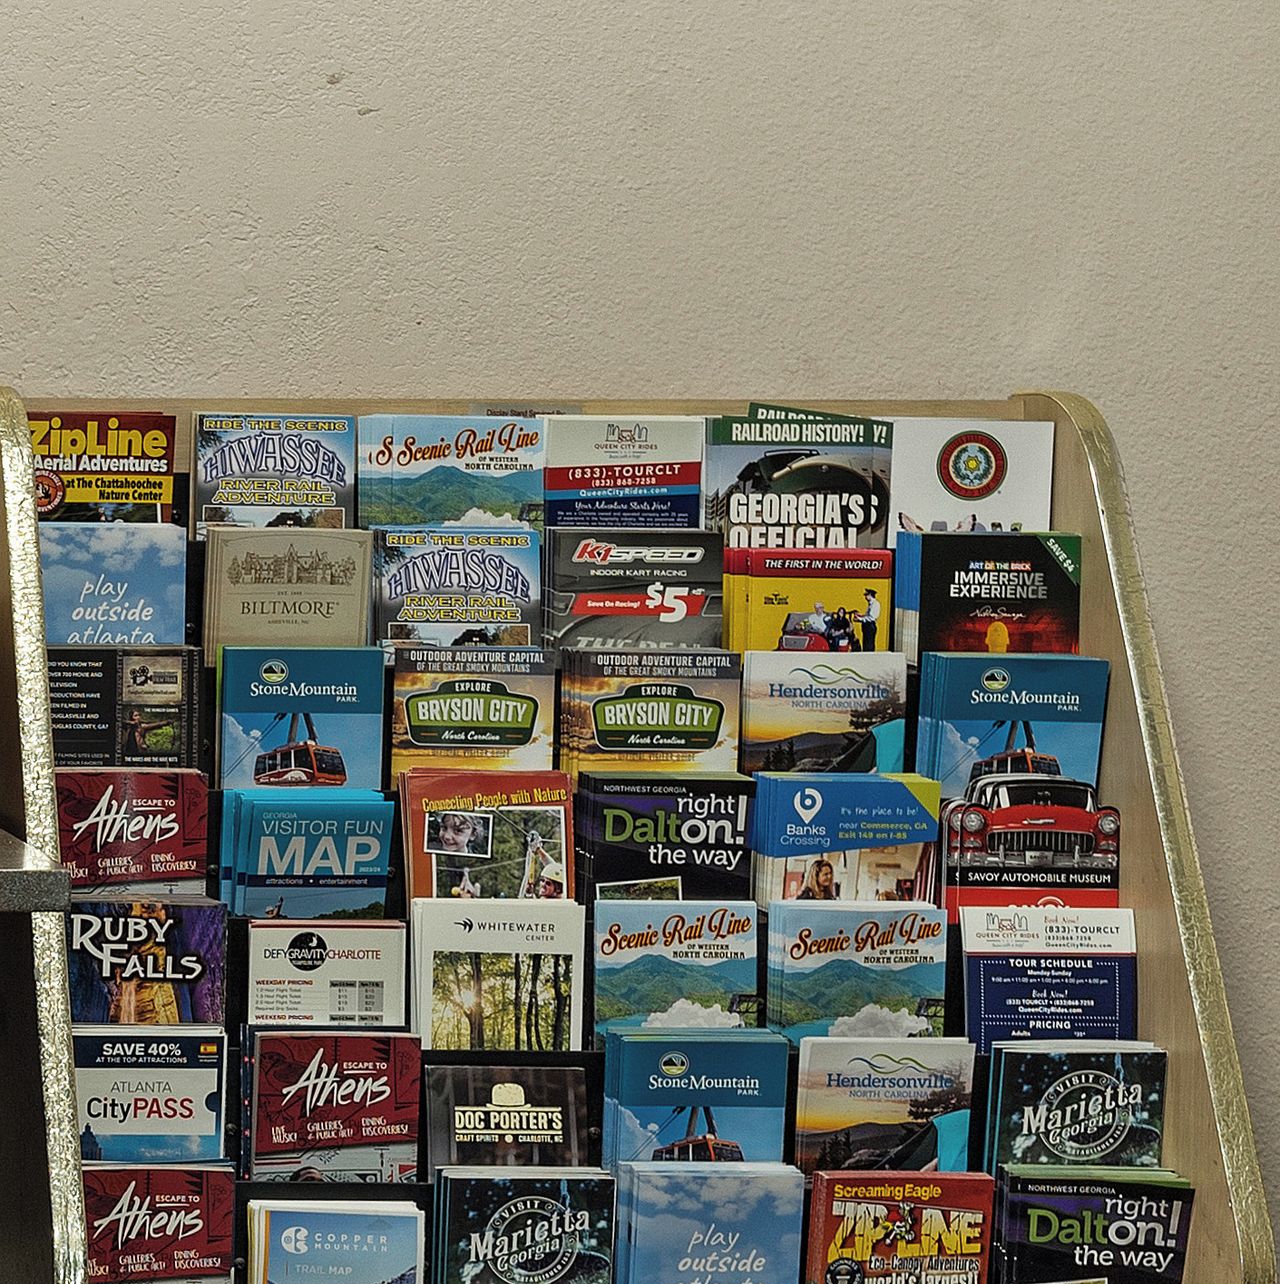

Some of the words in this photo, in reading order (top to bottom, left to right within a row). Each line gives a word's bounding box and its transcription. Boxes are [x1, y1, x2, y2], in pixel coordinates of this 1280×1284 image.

[204, 420, 242, 430] RIDE
[249, 421, 281, 430] THE
[286, 421, 346, 431] SCENIC
[732, 422, 800, 442] RAILROAD
[802, 424, 864, 443] HISTORY!
[27, 416, 167, 458] ZipLine
[397, 436, 450, 467] Scenic
[455, 427, 496, 459] Rail
[498, 422, 539, 450] Line
[34, 454, 77, 471] Aerial
[79, 455, 168, 472] Adventures
[204, 432, 346, 486] HIWASSEE
[569, 465, 681, 480] (833)-TOURCLT
[66, 480, 75, 489] at
[77, 478, 93, 489] The
[95, 478, 163, 490] Chattahoochee
[221, 480, 280, 492] RIVER
[284, 480, 330, 492] RAIL
[99, 490, 128, 500] Nature
[130, 490, 163, 500] Center
[215, 492, 335, 504] ADVENTURE
[729, 493, 864, 524] GEORGIA'S
[1046, 538, 1067, 562] SAVE
[765, 560, 783, 568] THE
[785, 560, 810, 568] FIRST
[812, 560, 822, 568] IN
[825, 560, 842, 569] THE
[845, 561, 882, 570] WORLD!
[954, 571, 1044, 586] IMMERSIVE
[80, 573, 128, 603] play
[950, 584, 1048, 599] EXPERIENCE
[645, 581, 689, 623] $5
[72, 599, 153, 622] outside
[67, 624, 155, 644] atlanta
[410, 651, 452, 662] OUTDOOR
[455, 651, 506, 662] ADVENTURE
[509, 652, 545, 663] CAPITAL
[417, 663, 426, 671] OF
[428, 663, 440, 671] THE
[443, 663, 464, 671] GREAT
[466, 663, 489, 672] SMOKY
[491, 663, 530, 672] MOUNTAINS
[455, 682, 492, 692] EXPLORE
[768, 683, 889, 699] Hendersonville
[418, 698, 484, 721] BRYSON
[489, 700, 527, 722] CITY
[441, 731, 466, 740] North
[467, 731, 500, 741] Carolina
[603, 785, 651, 793] NORTHWEST
[652, 786, 687, 794] GEORGIA
[133, 799, 162, 807] ESCAPE
[423, 797, 473, 812] Connecting
[476, 794, 509, 808] People
[510, 792, 531, 805] with
[533, 789, 567, 803] Nature
[677, 792, 735, 819] right
[73, 784, 180, 852] Athens
[262, 820, 337, 834] VISITOR
[344, 820, 383, 834] FUN
[787, 824, 826, 835] Banks
[780, 835, 830, 847] Crossing
[257, 836, 380, 875] MAP
[648, 844, 687, 864] the
[692, 849, 743, 871] way
[967, 872, 999, 883] SAVOY
[1002, 872, 1067, 883] AUTOMOBILE
[1069, 874, 1111, 884] MUSEUM
[477, 921, 555, 932] WHITEWATER
[71, 914, 174, 957] RUBY
[102, 943, 203, 980] FALLS
[1009, 959, 1036, 968] TOUR
[1040, 959, 1093, 968] SCHEDULE
[1029, 1020, 1071, 1030] PRICING
[103, 1043, 145, 1057] SAVE
[148, 1043, 181, 1057] 40%
[110, 1081, 173, 1094] ATLANTA
[282, 1047, 391, 1118] Athens
[1056, 1074, 1095, 1093] VISIT
[87, 1096, 195, 1124] CityPASS
[1022, 1084, 1142, 1134] Marietta
[455, 1112, 487, 1130] DOC
[490, 1112, 563, 1130] PORTER'S
[1049, 1111, 1113, 1144] Georgia
[834, 1184, 903, 1200] Screaming
[905, 1184, 942, 1200] Eagle
[93, 1181, 204, 1250] Athens
[314, 1233, 388, 1245] COPPER
[469, 1207, 591, 1262] Marietta
[687, 1224, 740, 1252] play
[314, 1243, 388, 1252] MOUNTAIN
[678, 1249, 767, 1272] outside
[928, 1255, 979, 1271] Adventures
[295, 1265, 325, 1275] TRAIL
[328, 1265, 353, 1275] MAP
